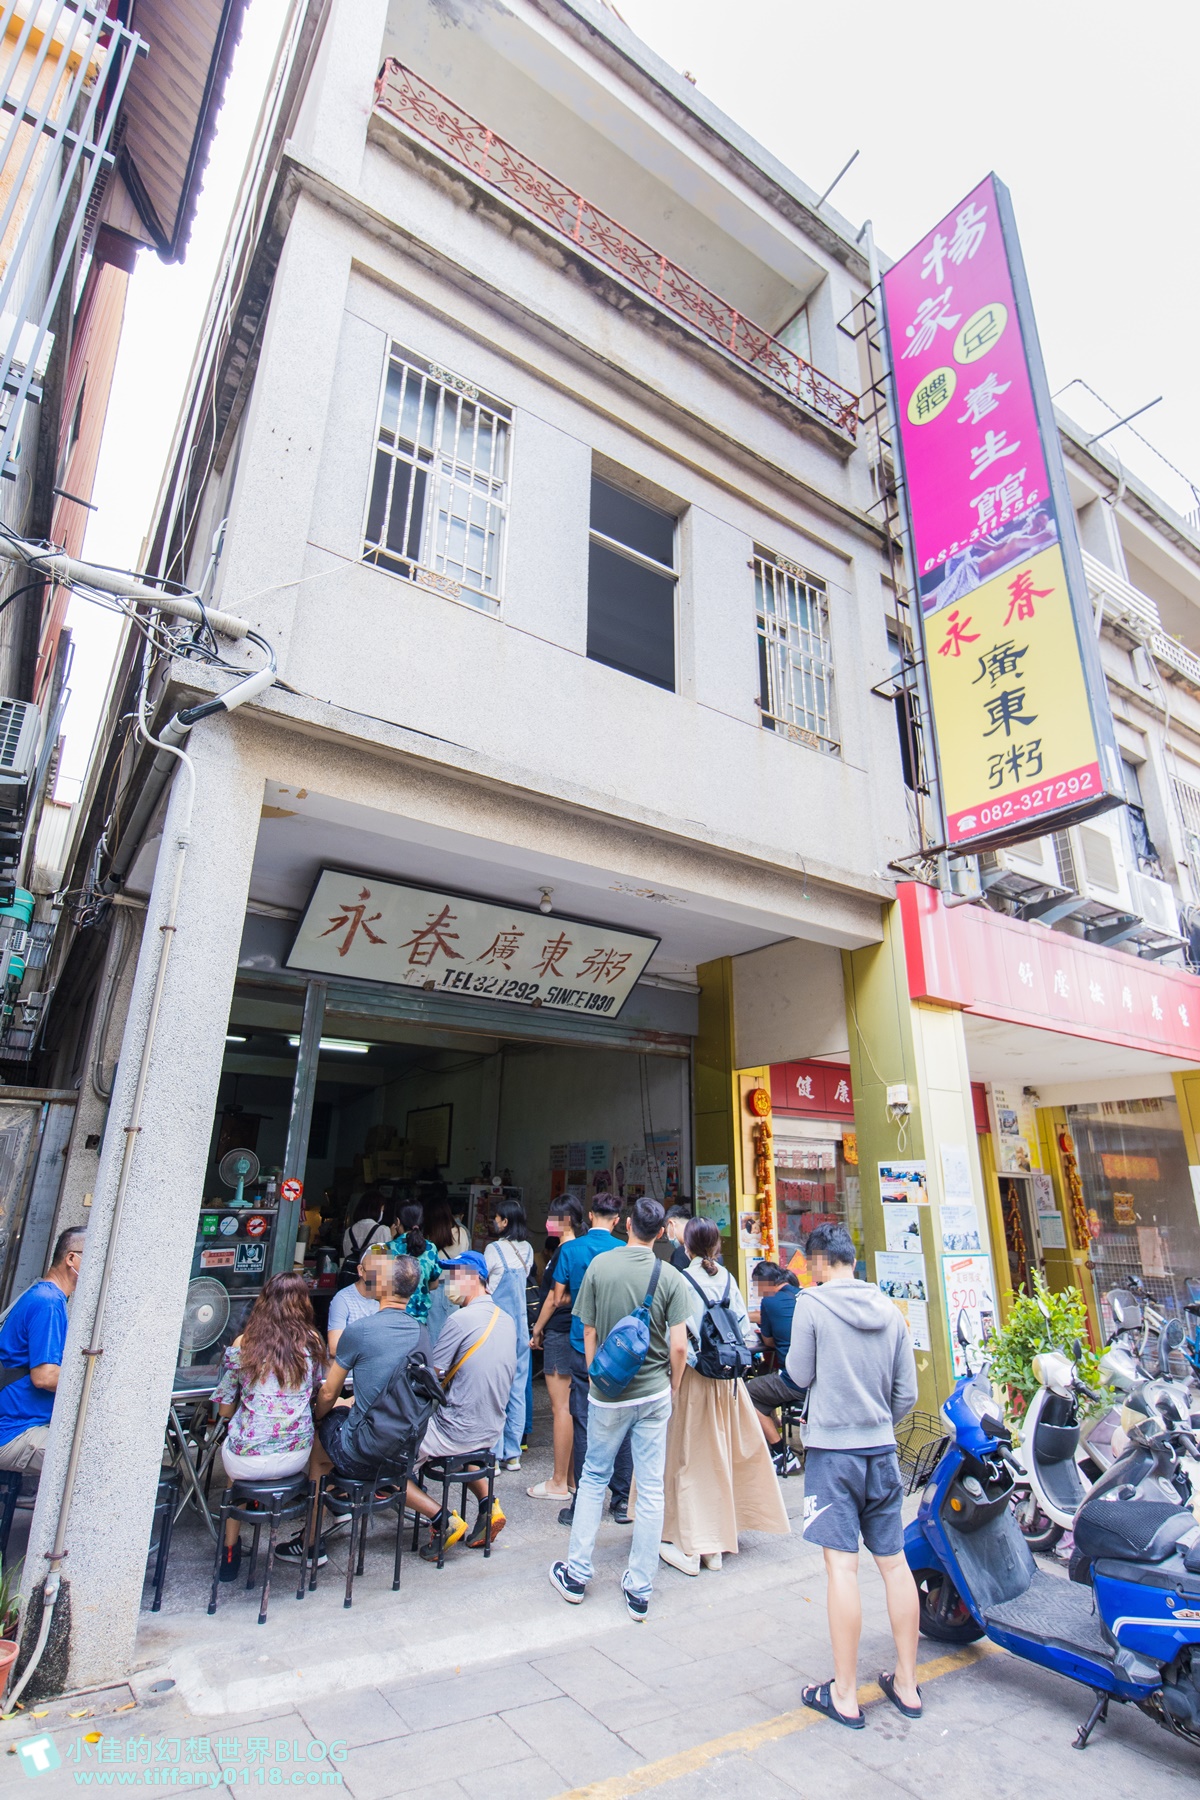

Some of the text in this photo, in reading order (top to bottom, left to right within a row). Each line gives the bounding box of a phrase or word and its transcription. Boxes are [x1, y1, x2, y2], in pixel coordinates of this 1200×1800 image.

[924, 489, 1039, 572] 082-311856
[980, 772, 1093, 825] 082-327292
[316, 886, 633, 985] 永春廣東粥
[776, 1148, 833, 1171] 足底按摩
[238, 1244, 263, 1263] NO
[951, 1288, 977, 1309] $20
